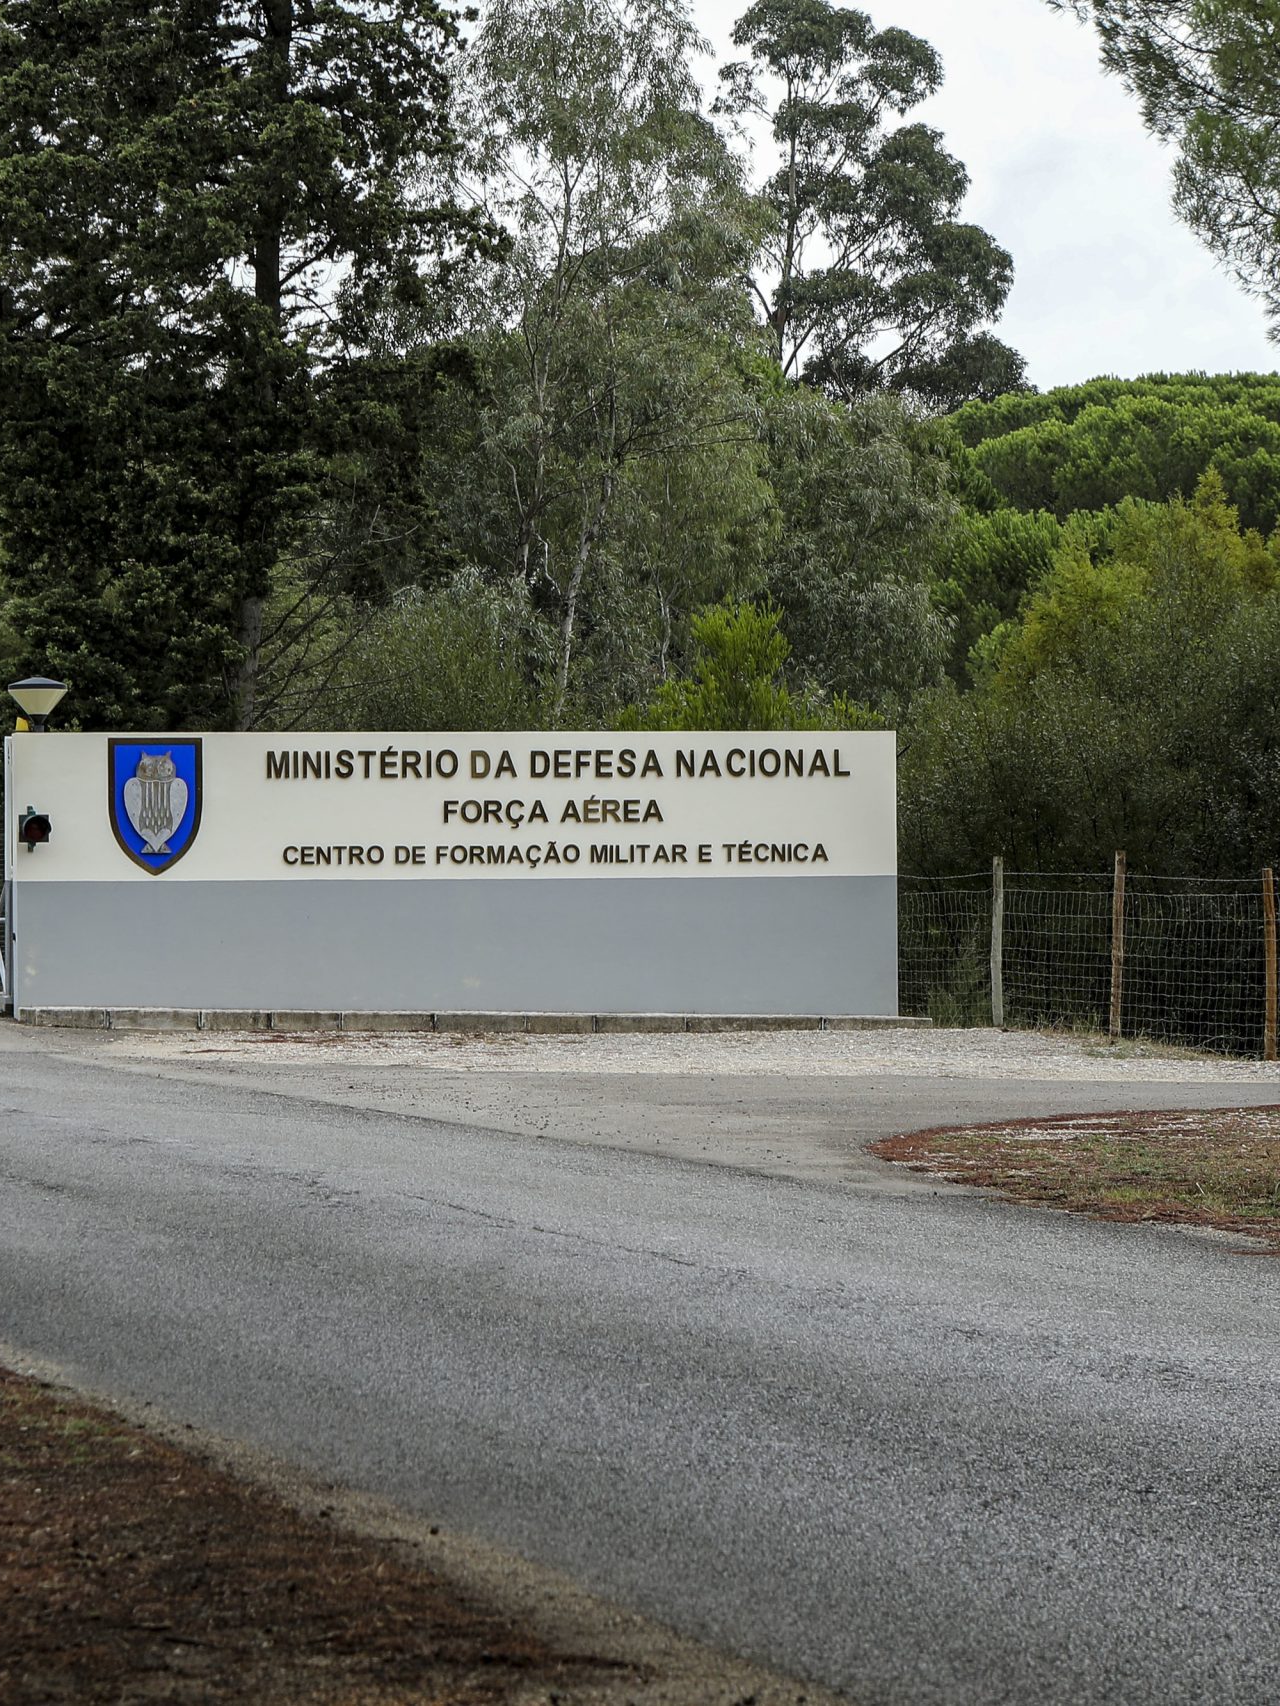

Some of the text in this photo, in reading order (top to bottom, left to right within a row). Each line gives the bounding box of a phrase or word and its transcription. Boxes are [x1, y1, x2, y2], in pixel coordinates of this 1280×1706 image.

[266, 745, 851, 780] MINISTÉRIO DA DEFESA NACIONAL
[443, 794, 664, 830] FORÇA AÉREA
[282, 839, 829, 869] CENTRO DE FORMAÇÃO MILITAR E TÉCNICA
